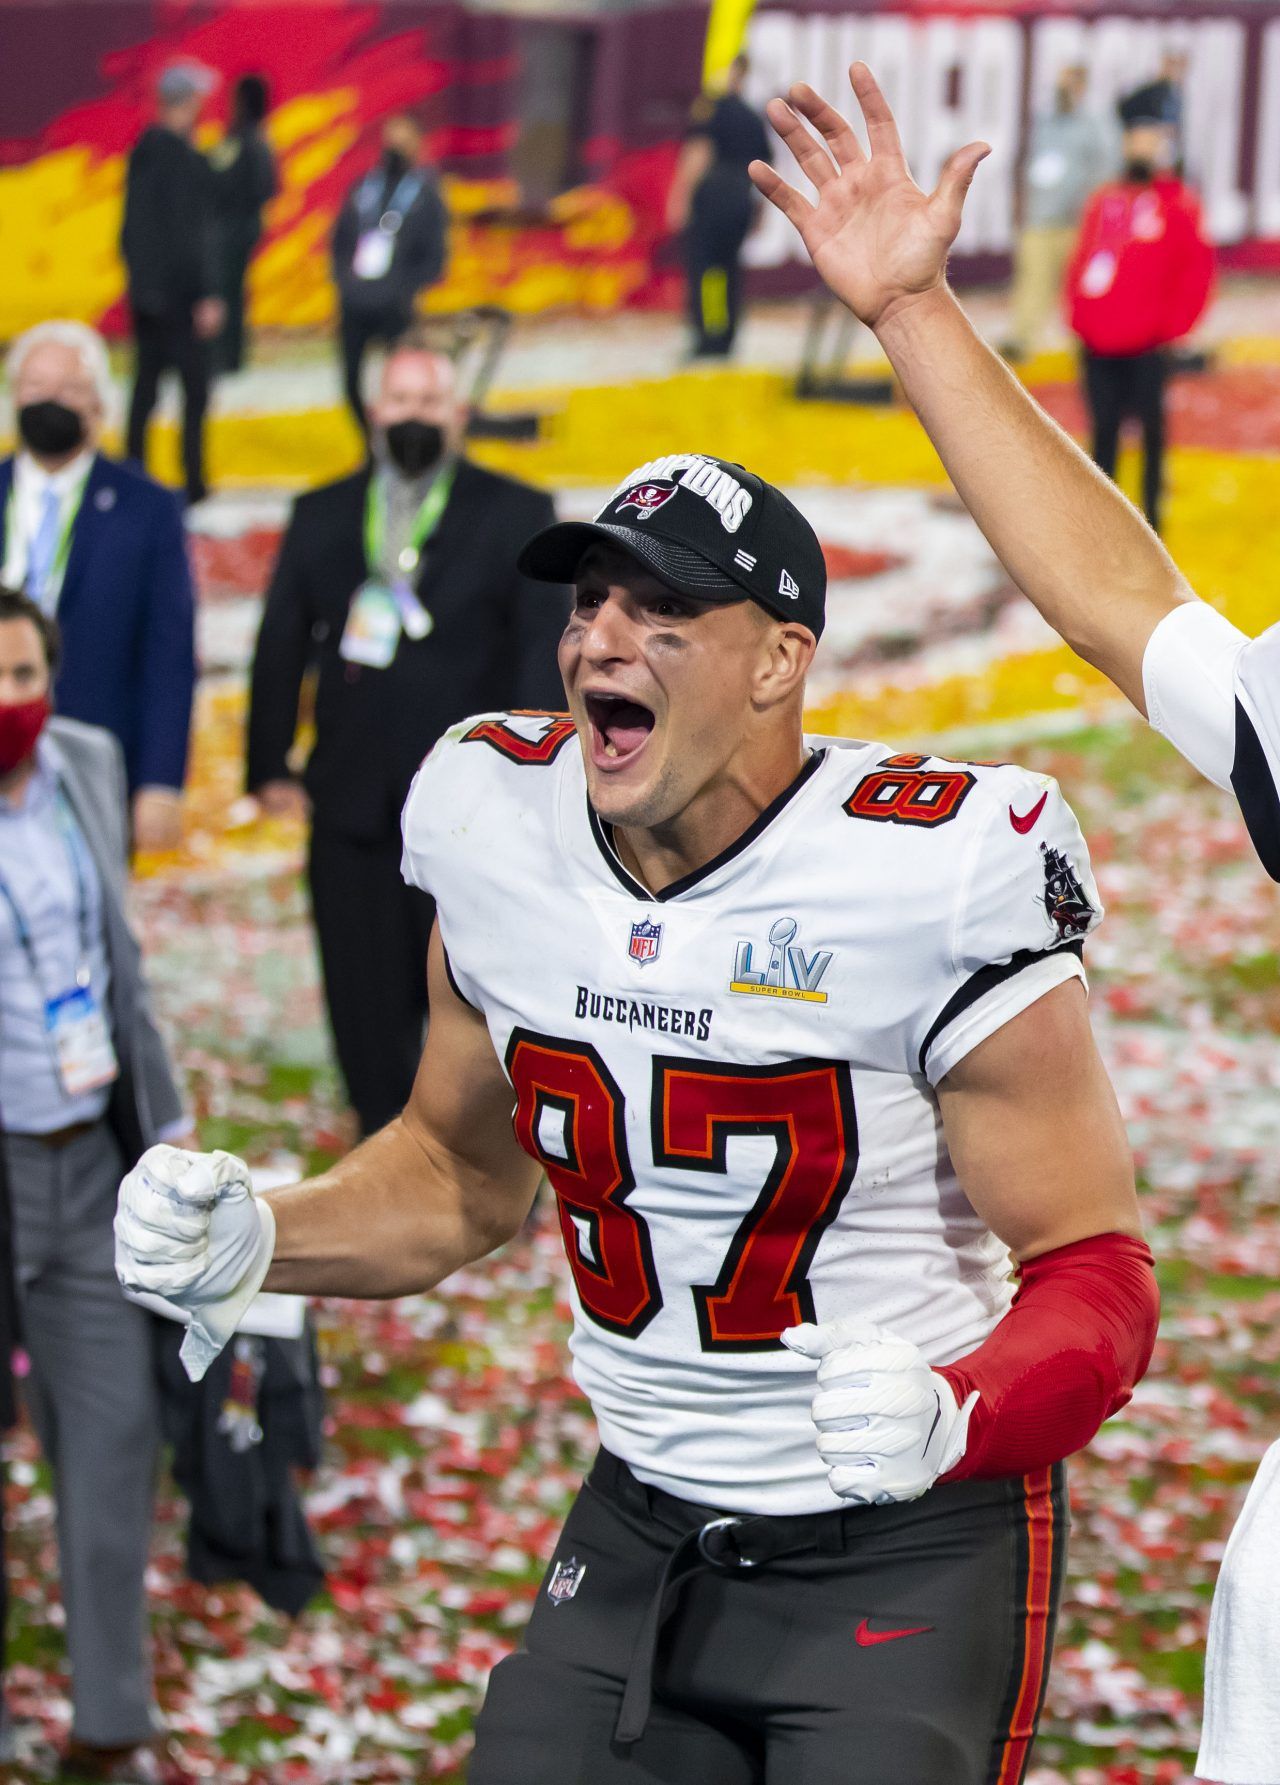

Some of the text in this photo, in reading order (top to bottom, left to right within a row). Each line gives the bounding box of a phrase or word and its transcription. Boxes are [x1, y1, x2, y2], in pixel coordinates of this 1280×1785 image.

[631, 937, 655, 958] NFL
[750, 986, 806, 998] SUPER BOWL
[575, 985, 713, 1041] BUCCANEERS
[505, 1026, 859, 1353] 87
